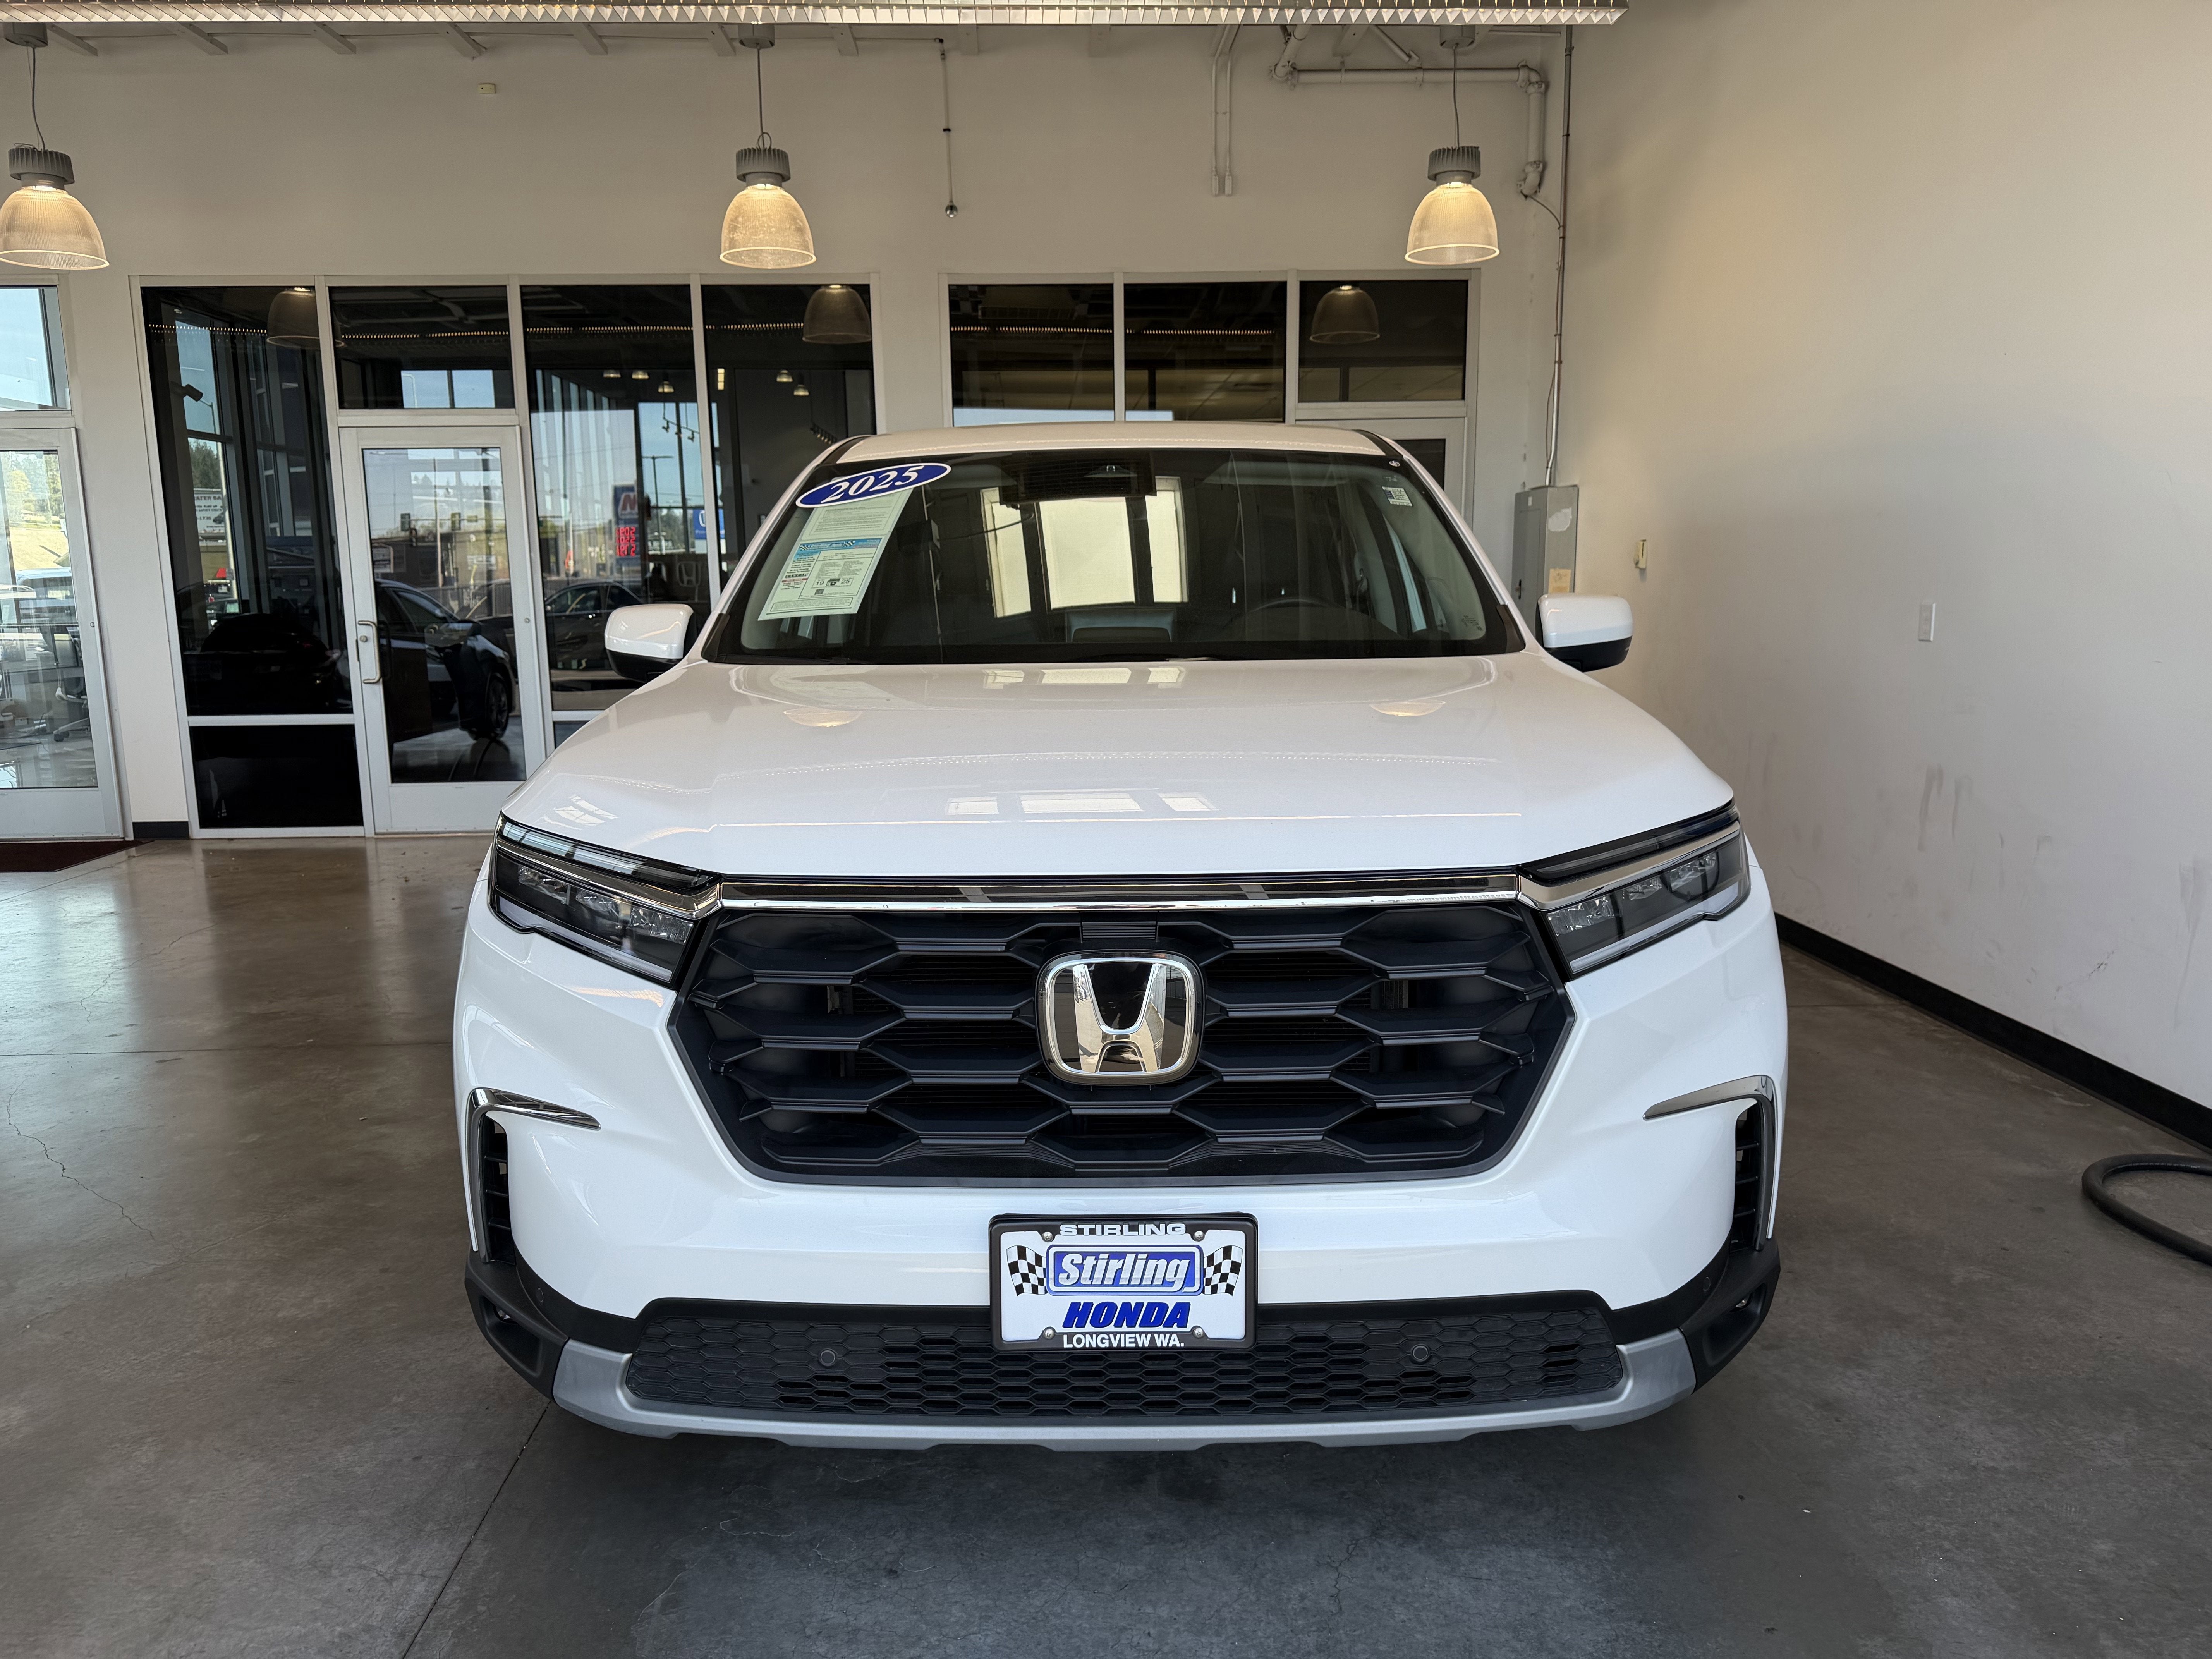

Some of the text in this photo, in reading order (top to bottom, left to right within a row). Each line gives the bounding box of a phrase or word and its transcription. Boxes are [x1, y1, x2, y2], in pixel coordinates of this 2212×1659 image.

[821, 465, 924, 503] 2025
[1060, 1223, 1186, 1236] STIRLING
[1058, 1253, 1190, 1292] Stirling
[1062, 1301, 1191, 1328] HONDA
[1063, 1333, 1185, 1348] LONGVIEW WA.
